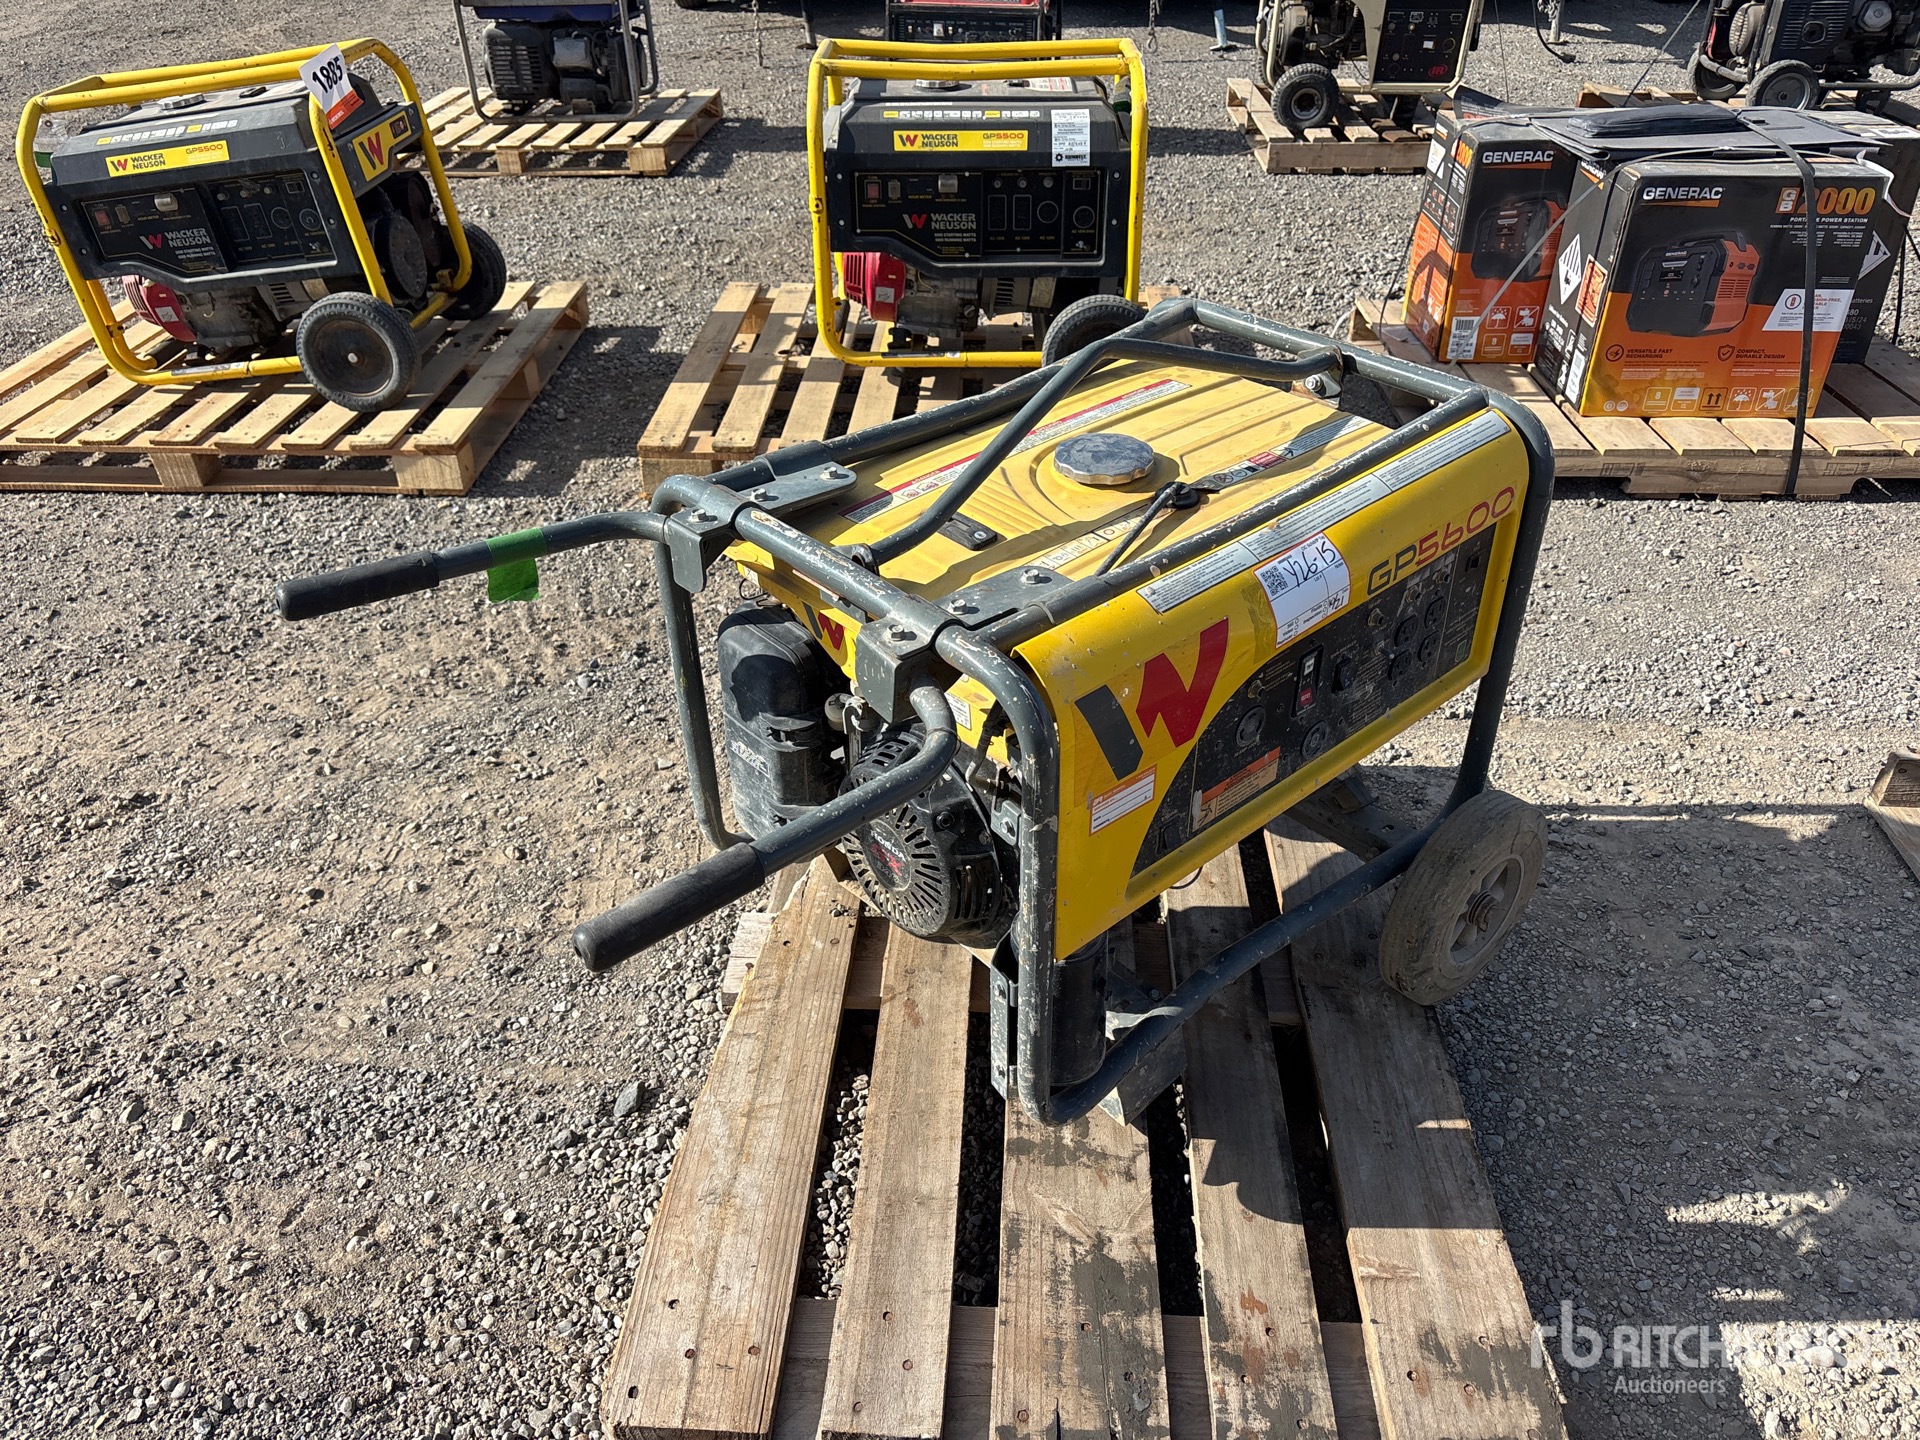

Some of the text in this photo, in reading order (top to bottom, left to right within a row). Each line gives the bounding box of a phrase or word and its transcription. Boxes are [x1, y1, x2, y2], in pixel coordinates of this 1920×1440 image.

[312, 56, 343, 94] 1885
[921, 133, 958, 141] WACKER
[982, 132, 1025, 140] GP5500
[921, 140, 959, 148] NEUSON
[130, 152, 165, 163] WACKER
[1482, 150, 1554, 164] GENERAC
[132, 159, 167, 170] NEUSON
[1642, 187, 1724, 200] GENERAC
[930, 213, 976, 222] WACKER
[931, 221, 977, 230] NEUSON
[164, 227, 208, 240] WACKER
[168, 235, 211, 248] NEUSON
[1366, 486, 1515, 596] GP5600
[870, 829, 907, 863] HONDA
